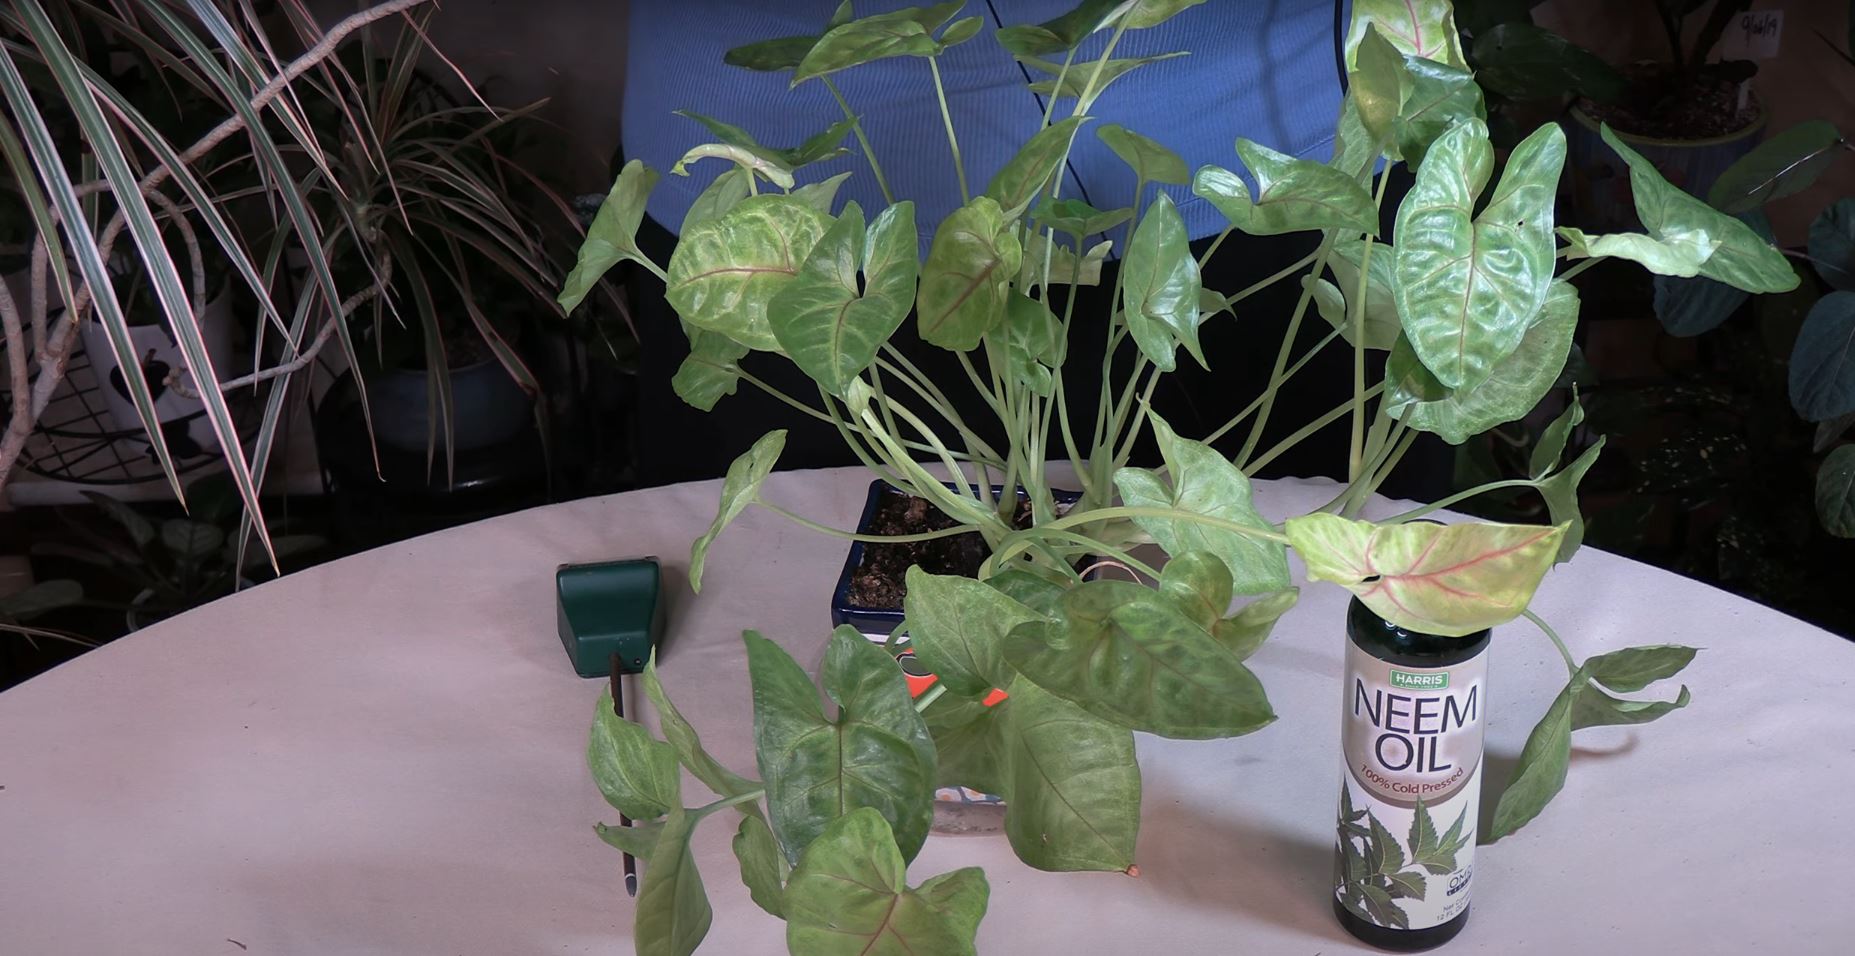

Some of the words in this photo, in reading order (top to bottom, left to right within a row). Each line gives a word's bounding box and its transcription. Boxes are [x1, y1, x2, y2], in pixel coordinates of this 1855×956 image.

[1396, 673, 1443, 685] HARRIS
[1355, 677, 1477, 735] NEEM
[1375, 733, 1452, 773] OIL
[1361, 764, 1391, 789] 100%
[1392, 782, 1420, 794] Cold
[1422, 767, 1464, 793] Pressed
